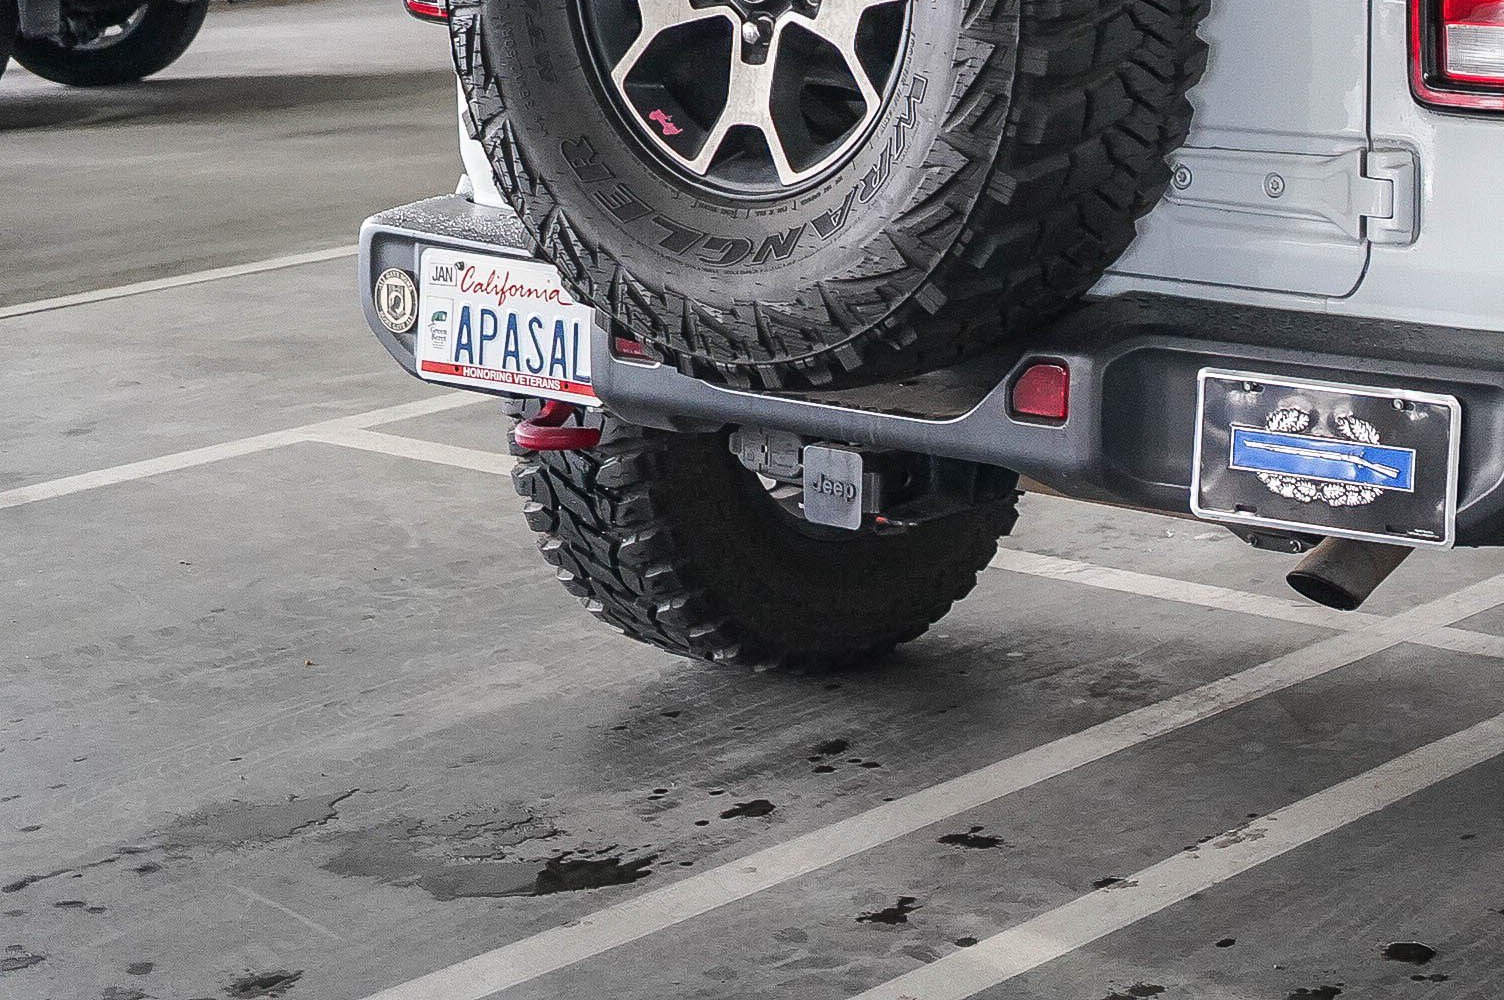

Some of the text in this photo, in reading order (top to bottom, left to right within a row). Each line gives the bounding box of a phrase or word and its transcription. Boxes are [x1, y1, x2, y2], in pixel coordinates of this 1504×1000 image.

[560, 73, 929, 268] WRANGLER
[432, 265, 453, 282] JAN
[461, 265, 574, 306] California
[454, 305, 590, 383] APASAL
[462, 366, 561, 391] HONORING VETERANS
[813, 473, 857, 503] Jeep
